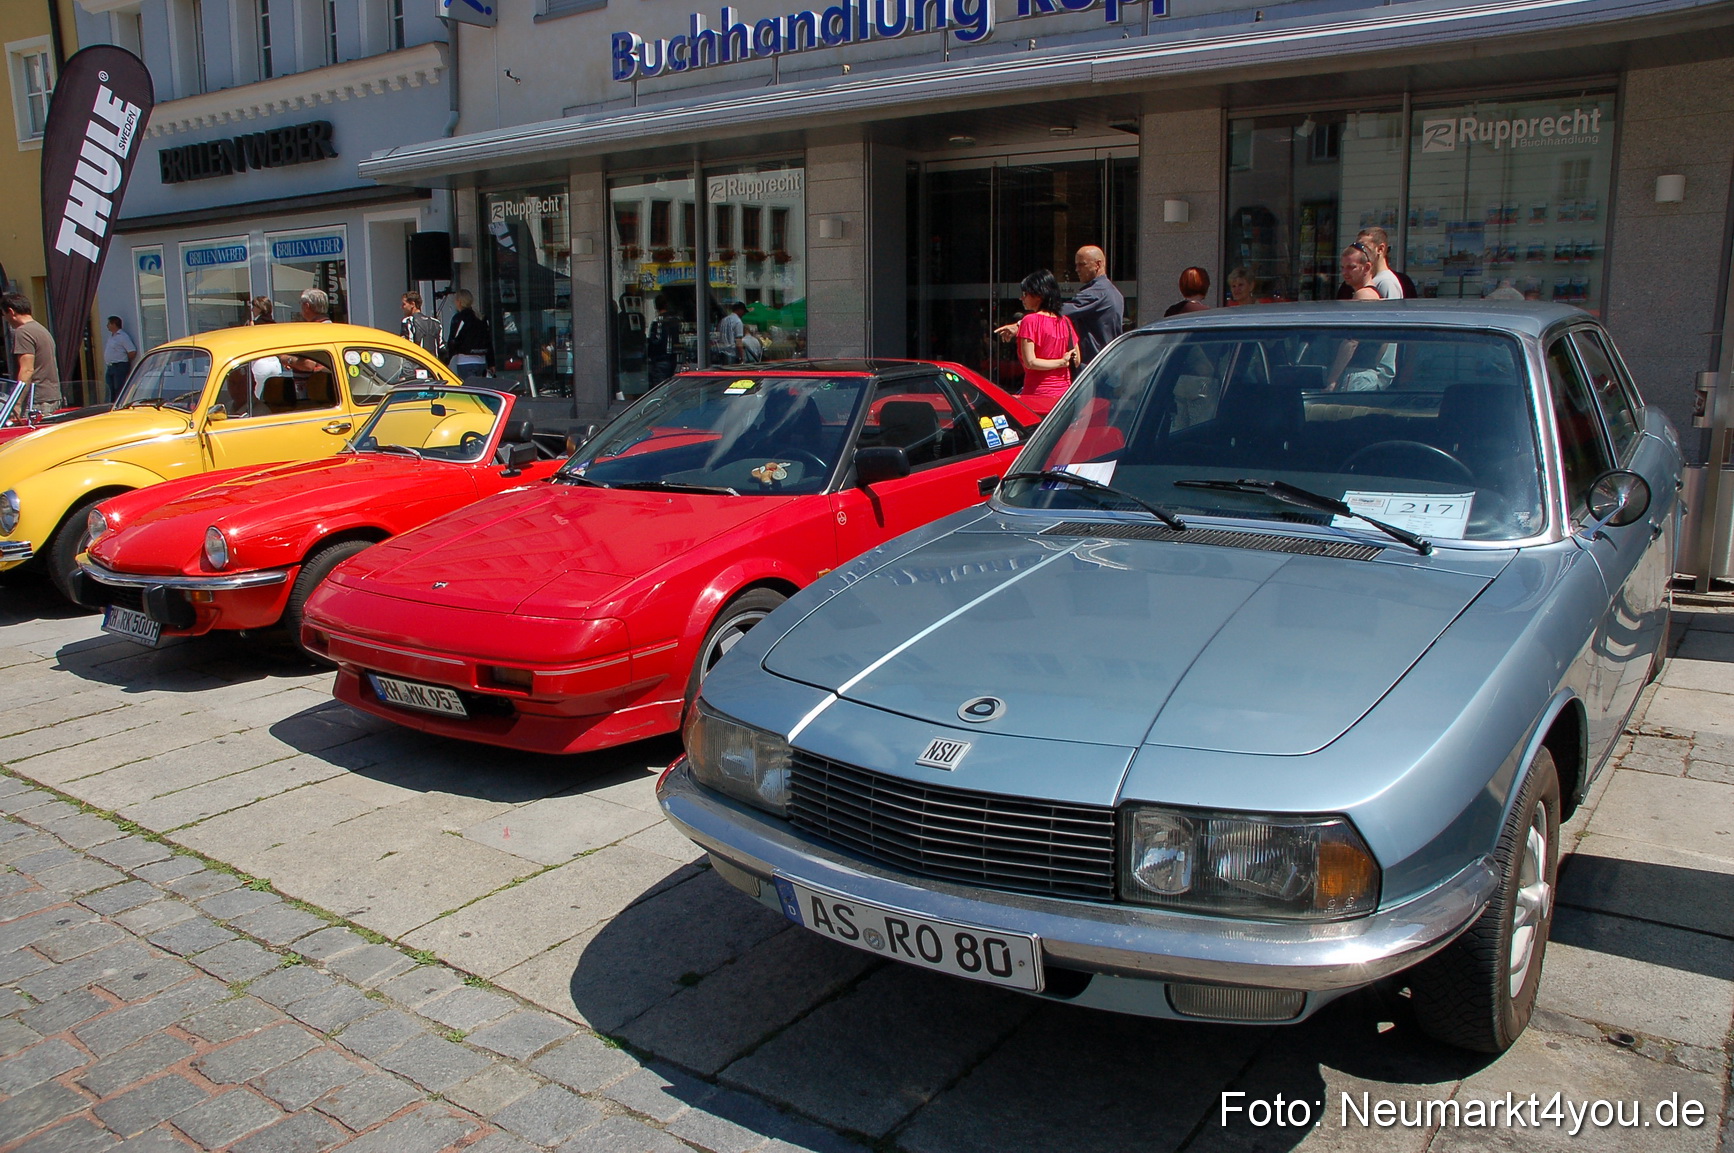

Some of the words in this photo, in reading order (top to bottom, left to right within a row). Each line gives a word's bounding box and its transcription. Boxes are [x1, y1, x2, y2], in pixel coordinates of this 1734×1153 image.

[611, 0, 992, 81] Buchhandlung
[118, 110, 136, 150] SWEDEN
[1459, 108, 1602, 149] Rupprecht
[1519, 134, 1599, 148] Buchhandlung
[159, 136, 246, 185] BRILLEN
[241, 120, 339, 170] WEBER
[55, 84, 142, 264] THULE
[727, 173, 802, 200] Rupprecht
[505, 196, 559, 220] Rupprecht
[188, 249, 219, 266] BRILLEN
[217, 247, 245, 263] WEBER
[276, 240, 308, 257] BRILLEN
[308, 238, 341, 255] WEBER
[1399, 502, 1454, 515] 217
[378, 679, 403, 701] RH
[404, 684, 432, 707] MK
[428, 689, 453, 710] 95
[923, 740, 963, 763] NSU
[810, 895, 860, 941] AS
[884, 916, 944, 964] RO
[954, 932, 1013, 979] 80
